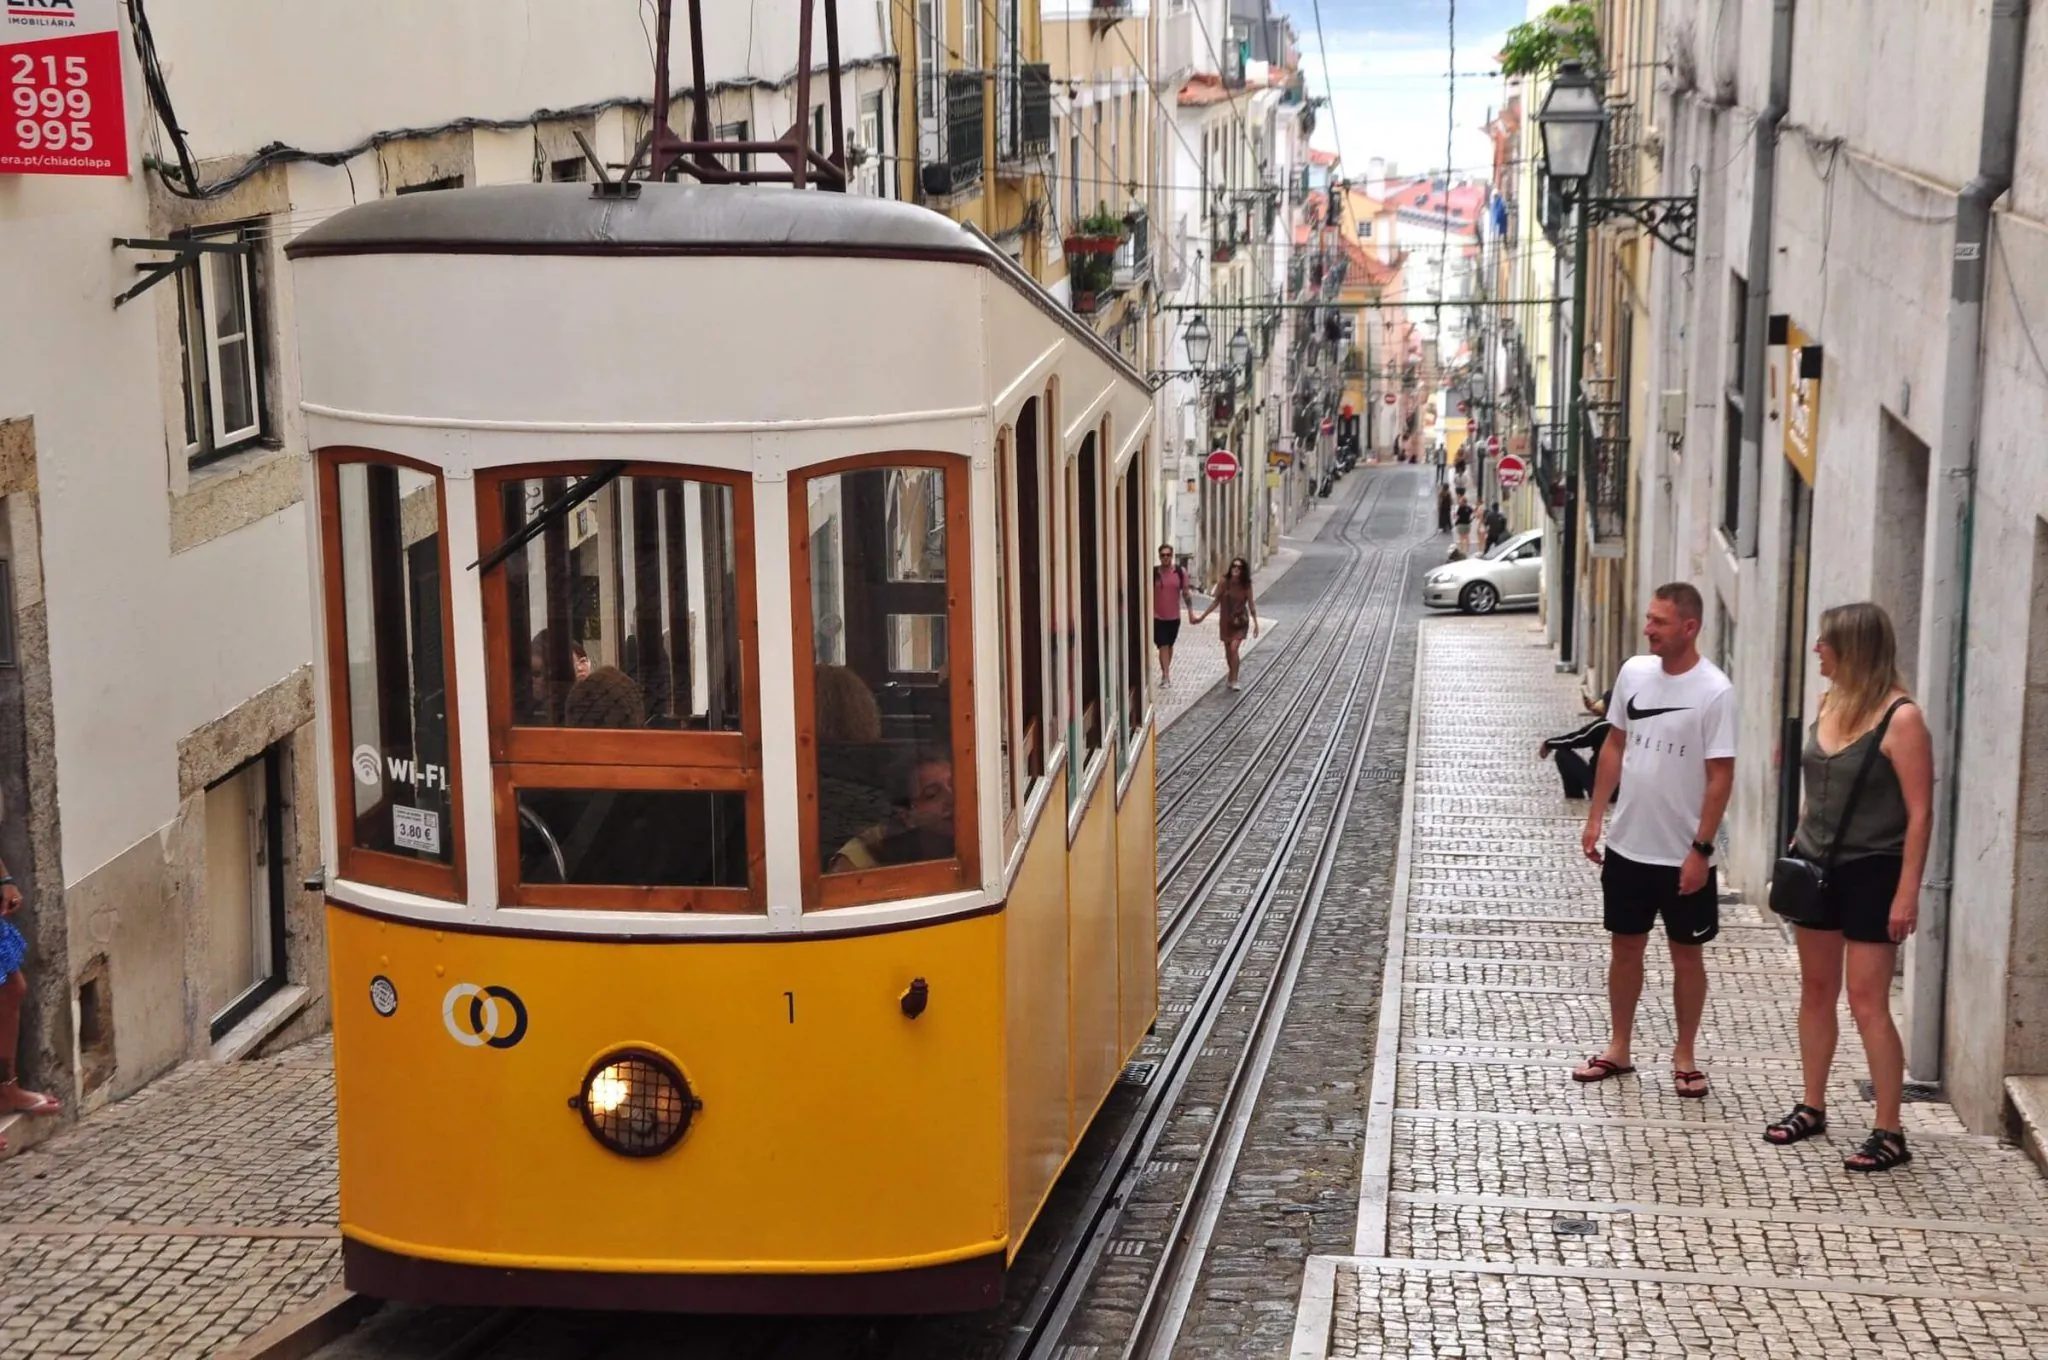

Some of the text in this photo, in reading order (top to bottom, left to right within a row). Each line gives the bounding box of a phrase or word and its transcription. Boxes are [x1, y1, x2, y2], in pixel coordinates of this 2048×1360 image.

[8, 17, 75, 27] IMOBILIÁRIA
[10, 53, 88, 87] 215
[13, 86, 91, 119] 999
[16, 119, 93, 151] 995
[1, 155, 111, 168] era.pt/chiadolapa
[387, 757, 446, 790] WI-FI
[400, 823, 422, 839] 3.80
[783, 992, 794, 1024] 1
